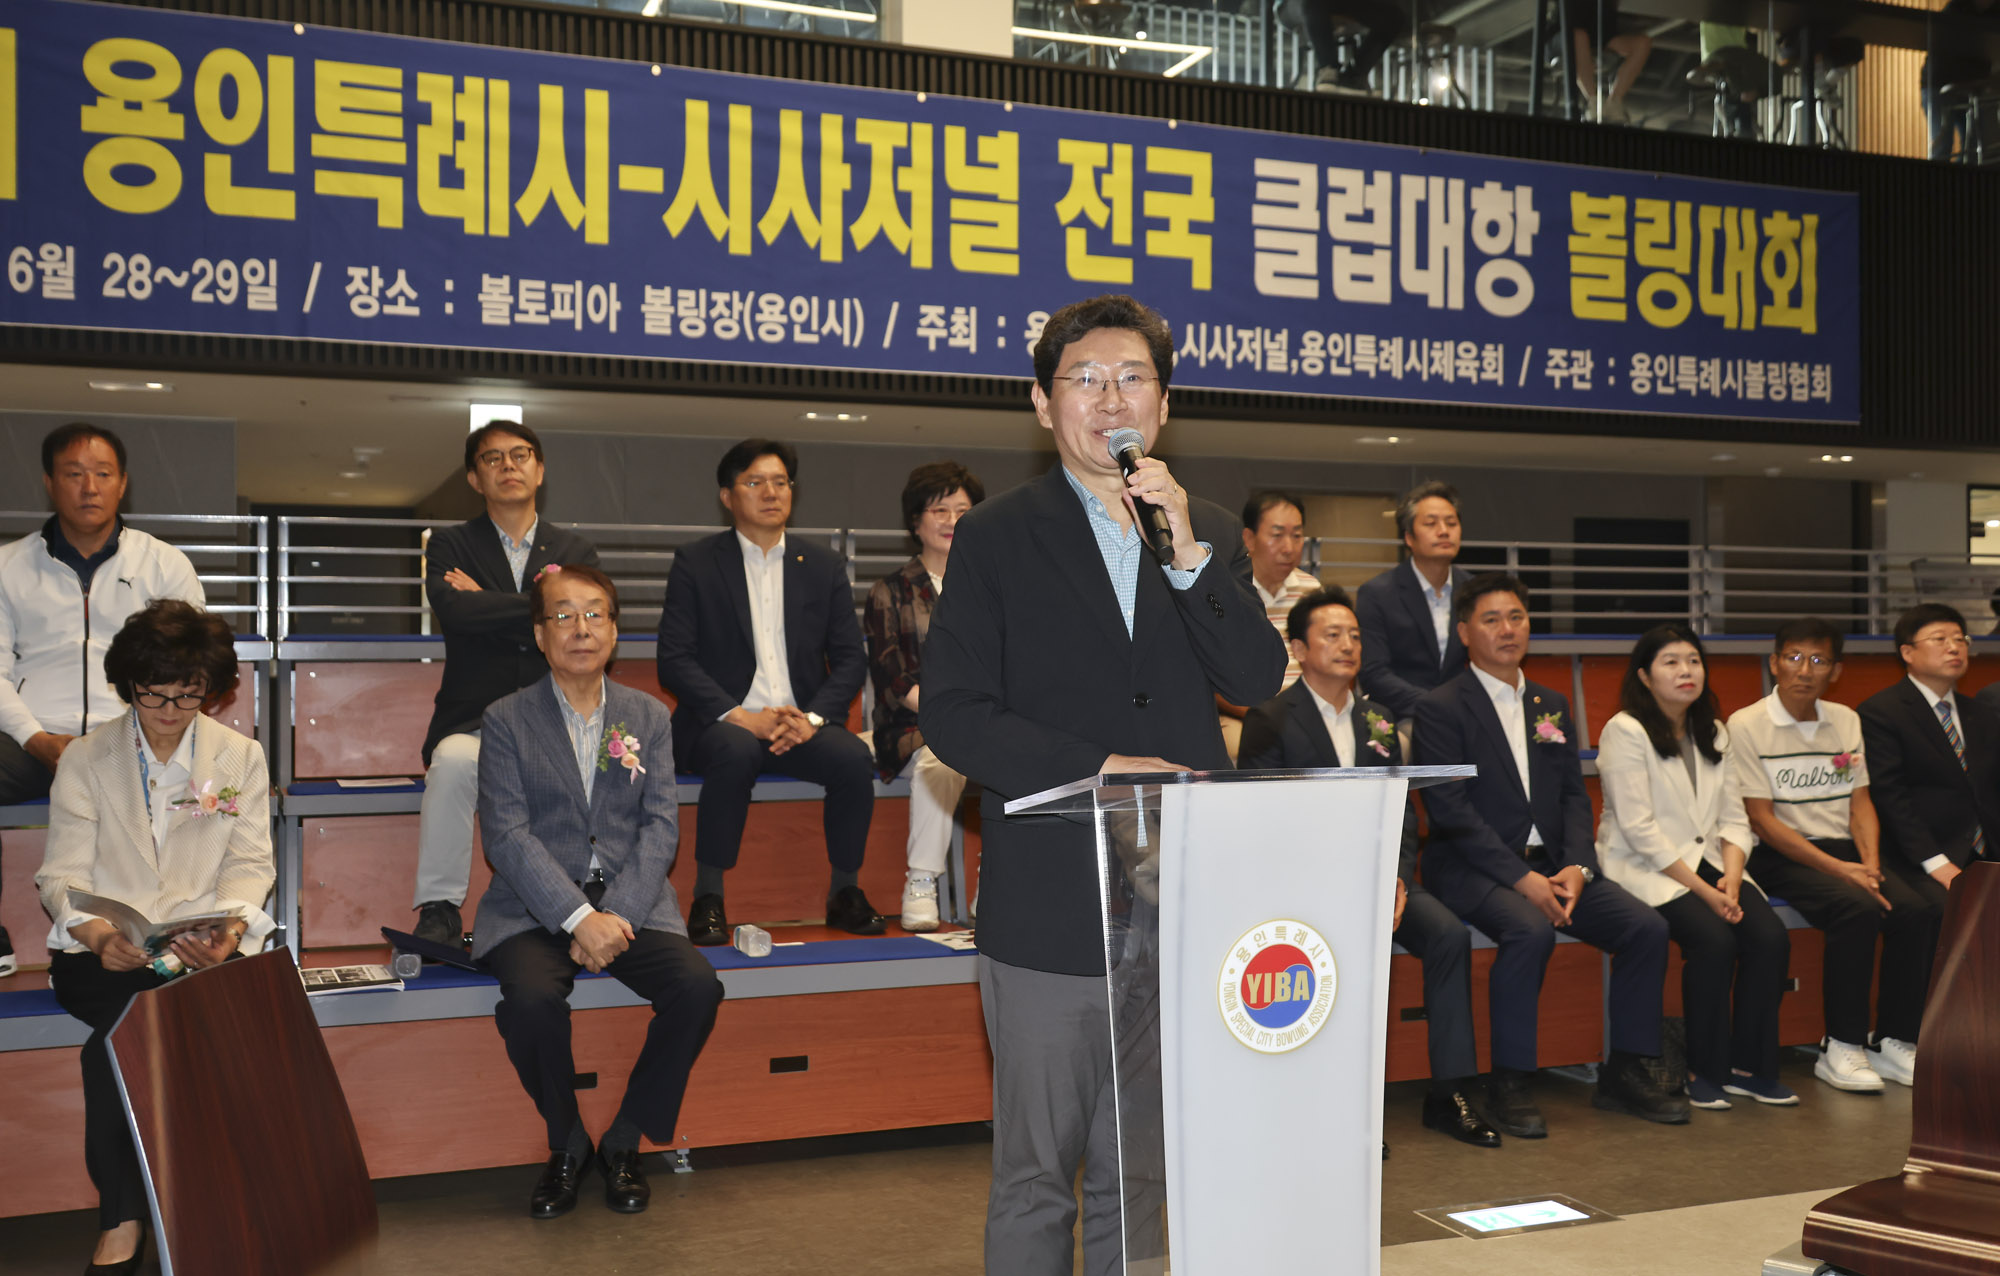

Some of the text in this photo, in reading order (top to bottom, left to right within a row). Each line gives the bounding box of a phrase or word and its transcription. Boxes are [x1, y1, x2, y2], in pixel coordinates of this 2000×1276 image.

[81, 37, 1020, 276] 용인특례시-시사저널
[1054, 138, 1215, 291] 전국
[1252, 157, 1541, 318] 클럽대항
[1567, 190, 1819, 334] 볼링대회
[7, 242, 76, 300] 6월
[101, 251, 279, 311] 28~29일
[344, 265, 421, 318] 장소
[477, 273, 622, 333] 볼토피아
[640, 284, 865, 348] 볼링장(용인시)
[916, 304, 978, 353] 주최
[1544, 347, 1595, 391] 주관
[1629, 352, 1832, 403] 용인특례시볼링협회
[1236, 926, 1324, 963] 용인특례시
[1223, 974, 1333, 1047] YONGIN SPECIAL CITY BOWLING ASSOCIATION
[1246, 970, 1310, 1004] YIBA
